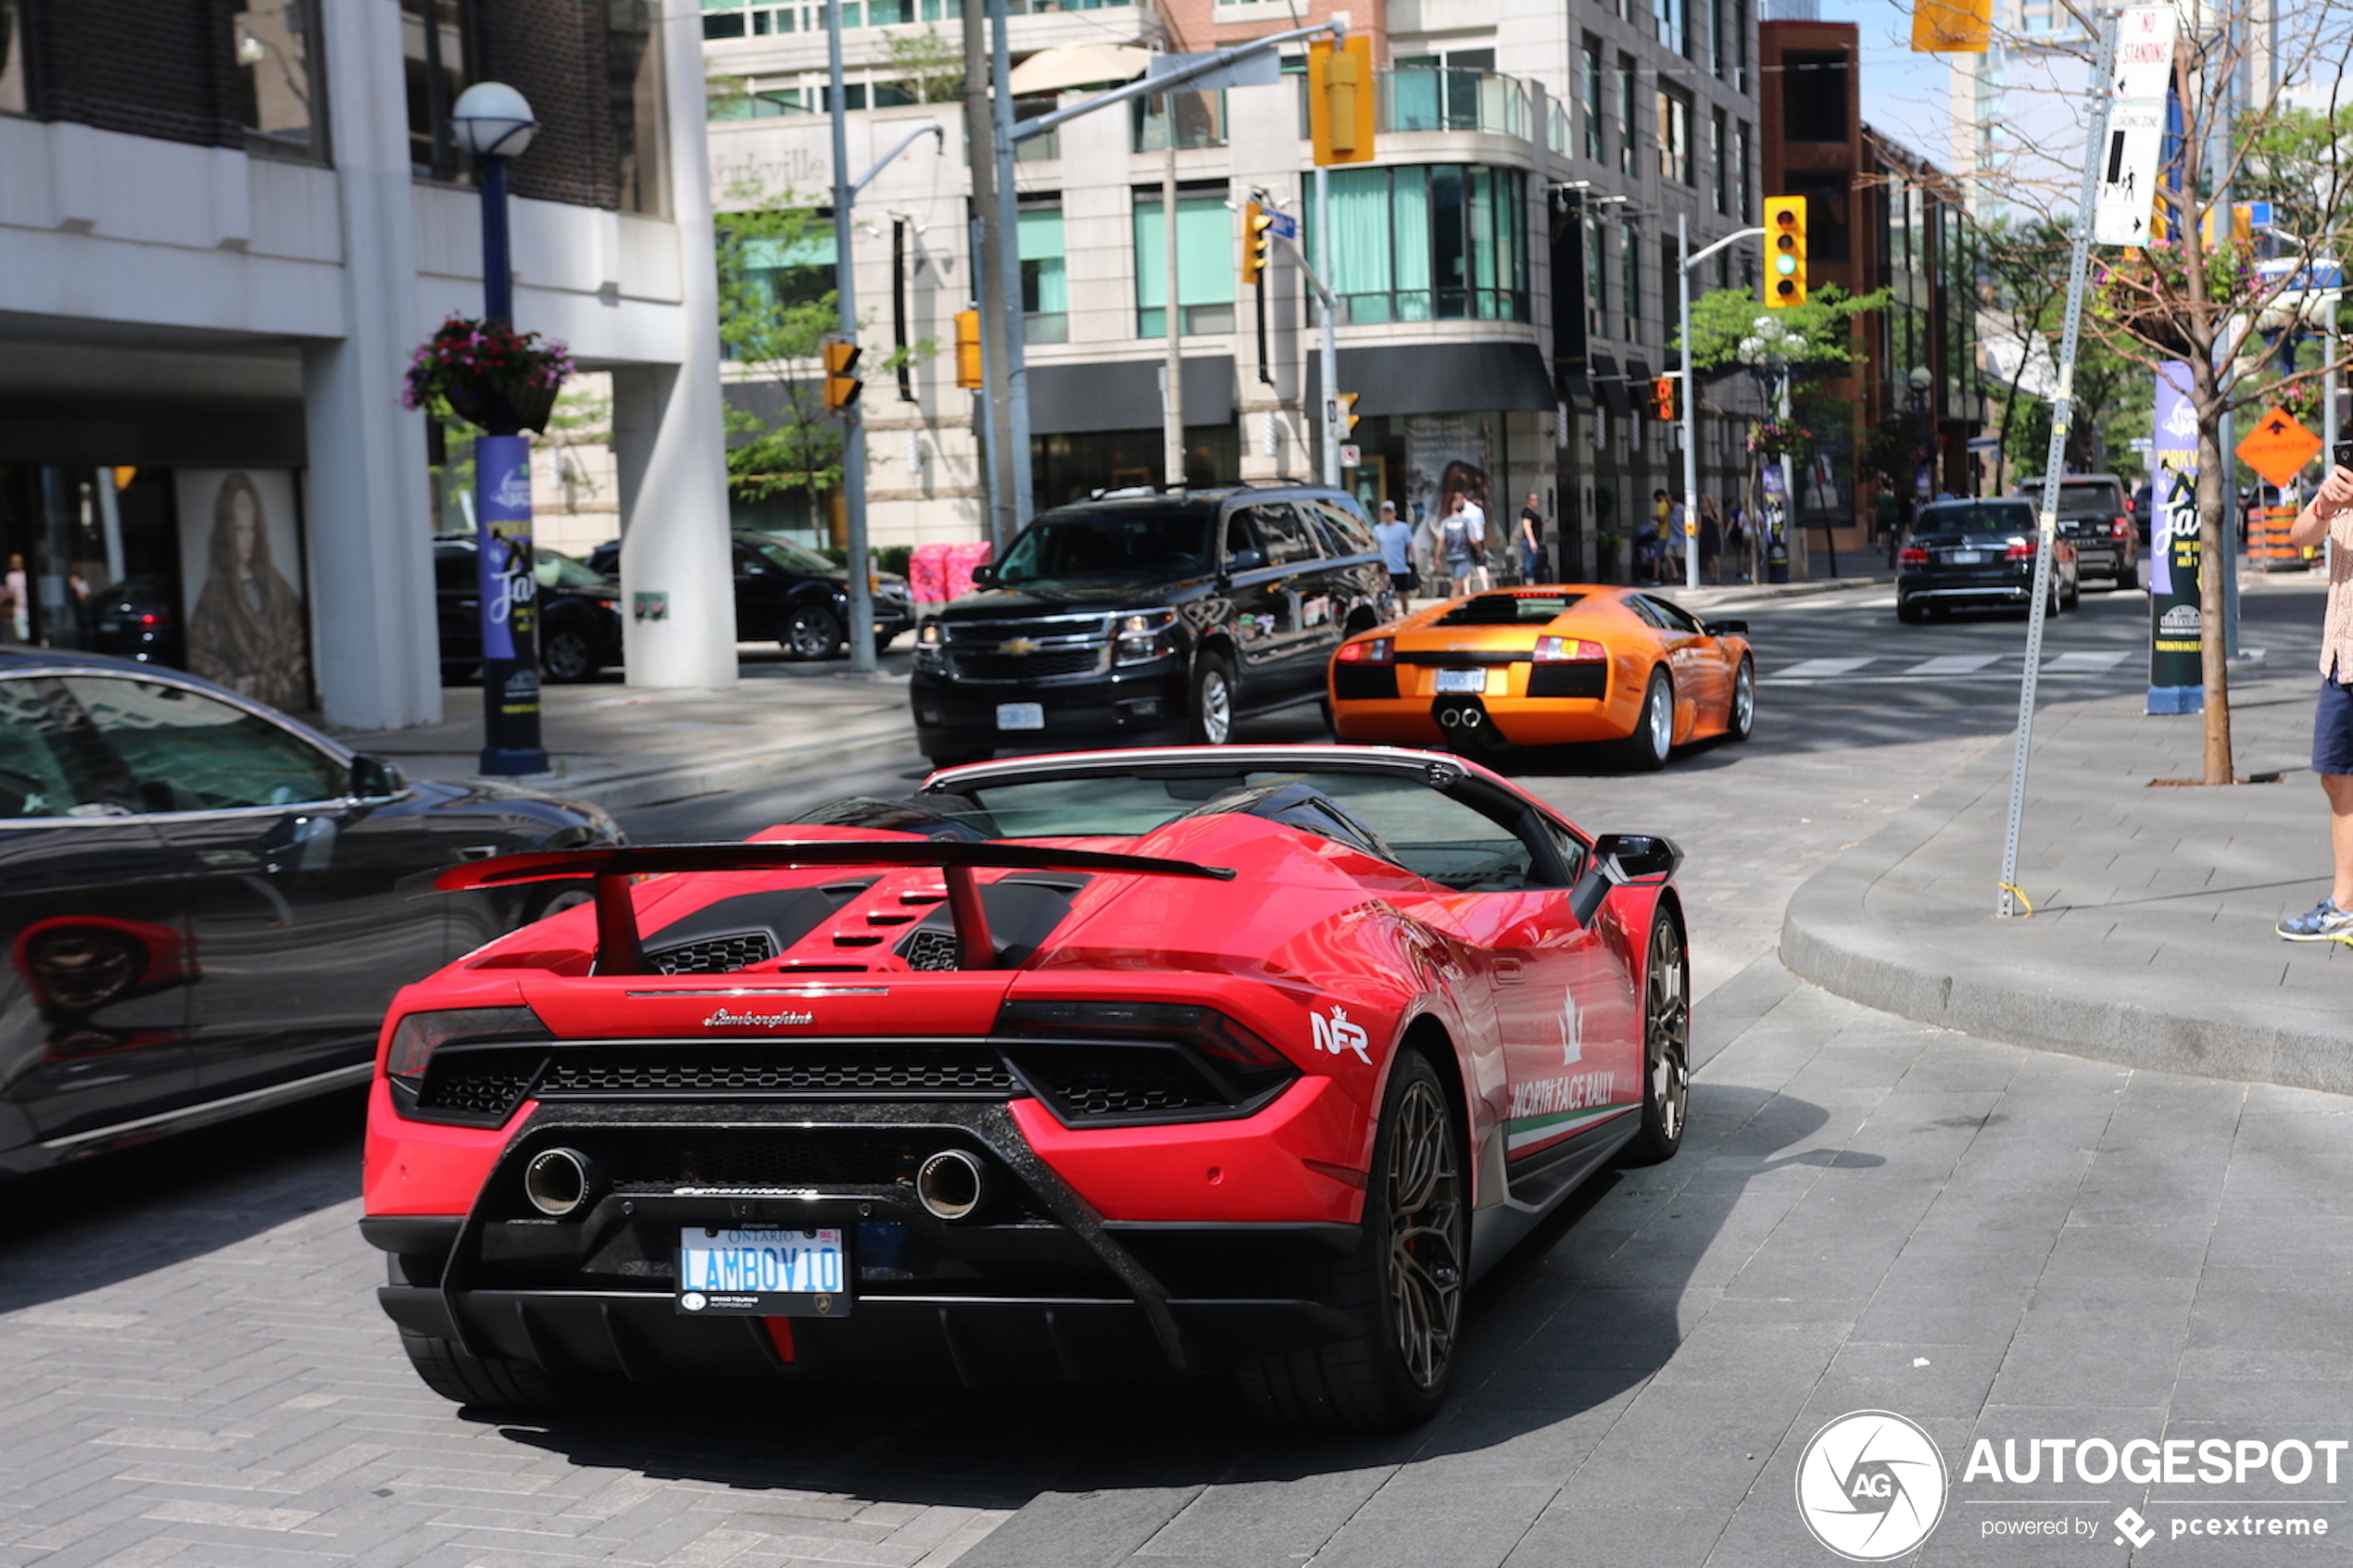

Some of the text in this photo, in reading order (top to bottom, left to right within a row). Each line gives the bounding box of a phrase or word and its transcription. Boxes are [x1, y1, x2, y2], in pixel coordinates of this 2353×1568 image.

[2142, 12, 2156, 32] NO
[2122, 42, 2168, 64] STANDING
[2113, 115, 2159, 128] LOADING ZONE
[2154, 500, 2201, 556] Ja
[489, 570, 537, 623] Ja
[703, 1008, 814, 1028] Lamborghini
[1510, 1071, 1616, 1119] NORTH FACE RALLY
[683, 1248, 838, 1291] LAMBOV10
